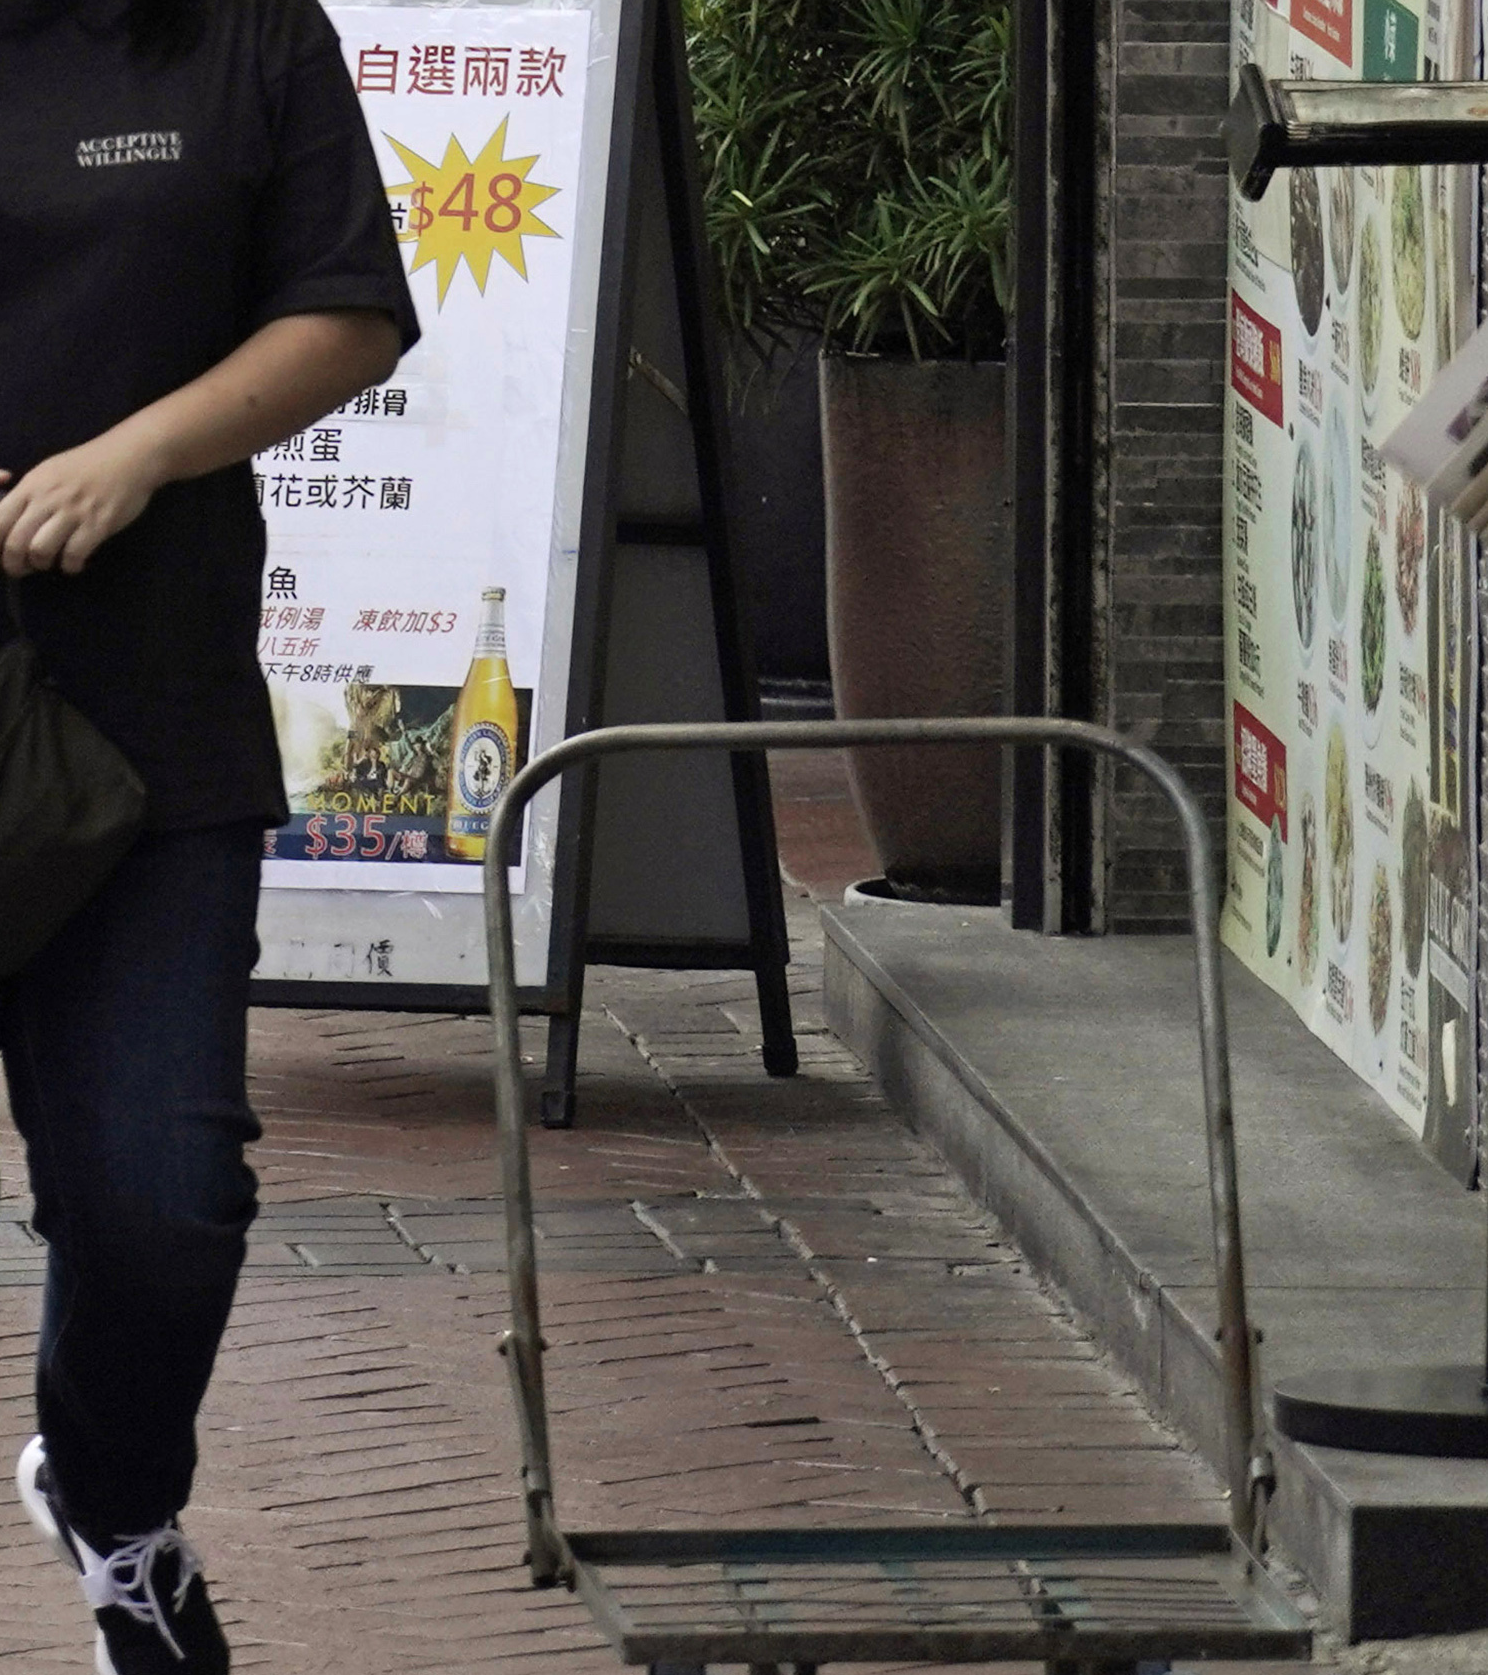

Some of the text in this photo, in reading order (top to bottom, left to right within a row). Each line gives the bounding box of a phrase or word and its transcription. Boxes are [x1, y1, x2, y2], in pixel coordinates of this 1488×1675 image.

[355, 43, 568, 98] 自選兩款
[76, 145, 182, 168] WILLINGLY
[407, 172, 523, 237] $48
[337, 388, 408, 417] 排骨
[255, 427, 342, 463] 煎蛋
[265, 565, 298, 600] 魚
[258, 636, 321, 658] 八五折
[307, 791, 436, 815] MOMENT
